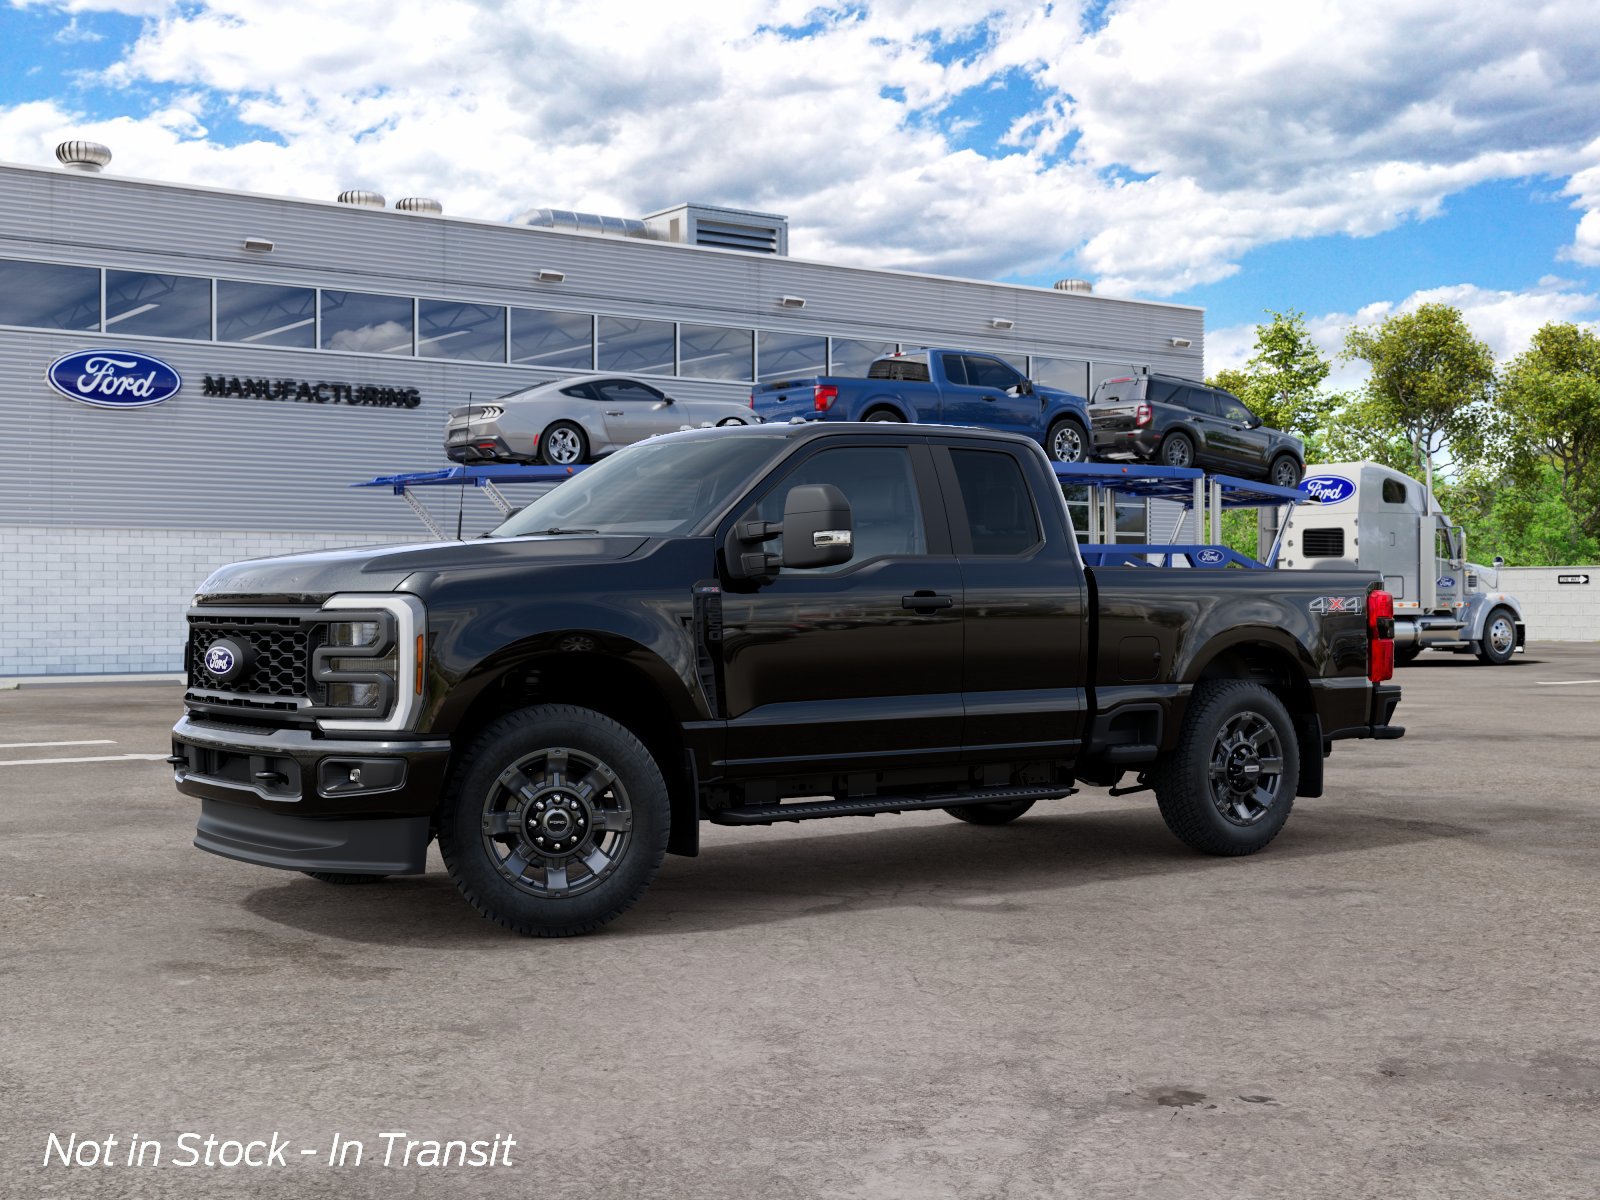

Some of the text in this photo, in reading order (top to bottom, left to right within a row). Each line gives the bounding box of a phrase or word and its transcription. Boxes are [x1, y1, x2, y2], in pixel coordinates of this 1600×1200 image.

[77, 357, 157, 397] Ford
[202, 373, 421, 408] MANUFACTURING
[1306, 480, 1343, 499] Ford
[209, 649, 228, 670] Ford
